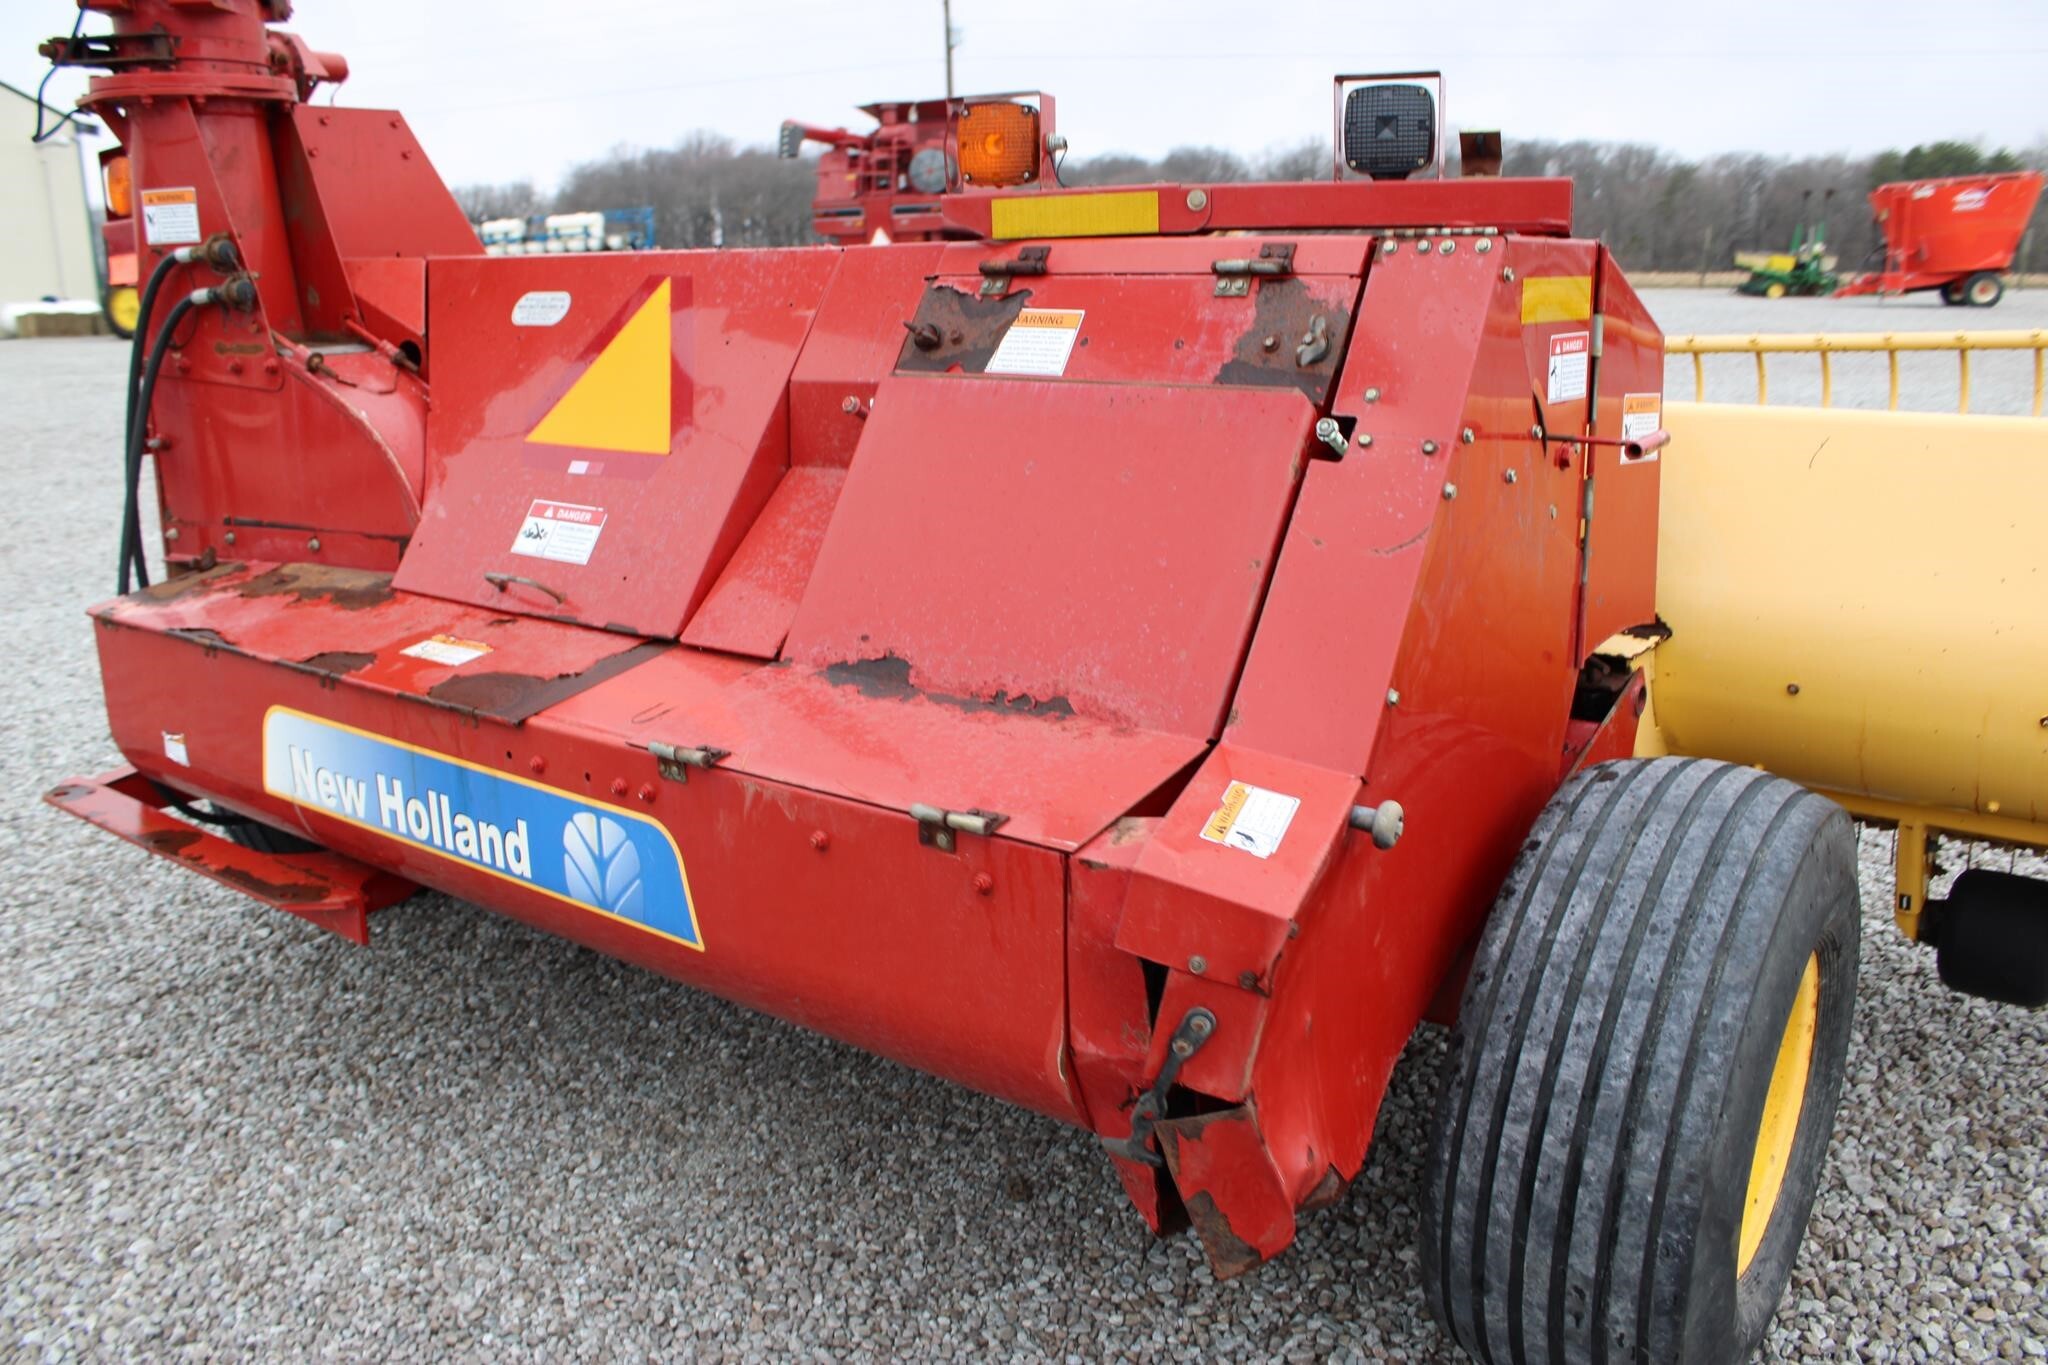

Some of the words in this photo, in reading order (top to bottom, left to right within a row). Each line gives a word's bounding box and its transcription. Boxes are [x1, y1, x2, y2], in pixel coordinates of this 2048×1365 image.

[1562, 338, 1583, 353] DANGER
[556, 507, 592, 523] DANGER
[288, 744, 367, 819] New
[375, 772, 532, 879] Holland
